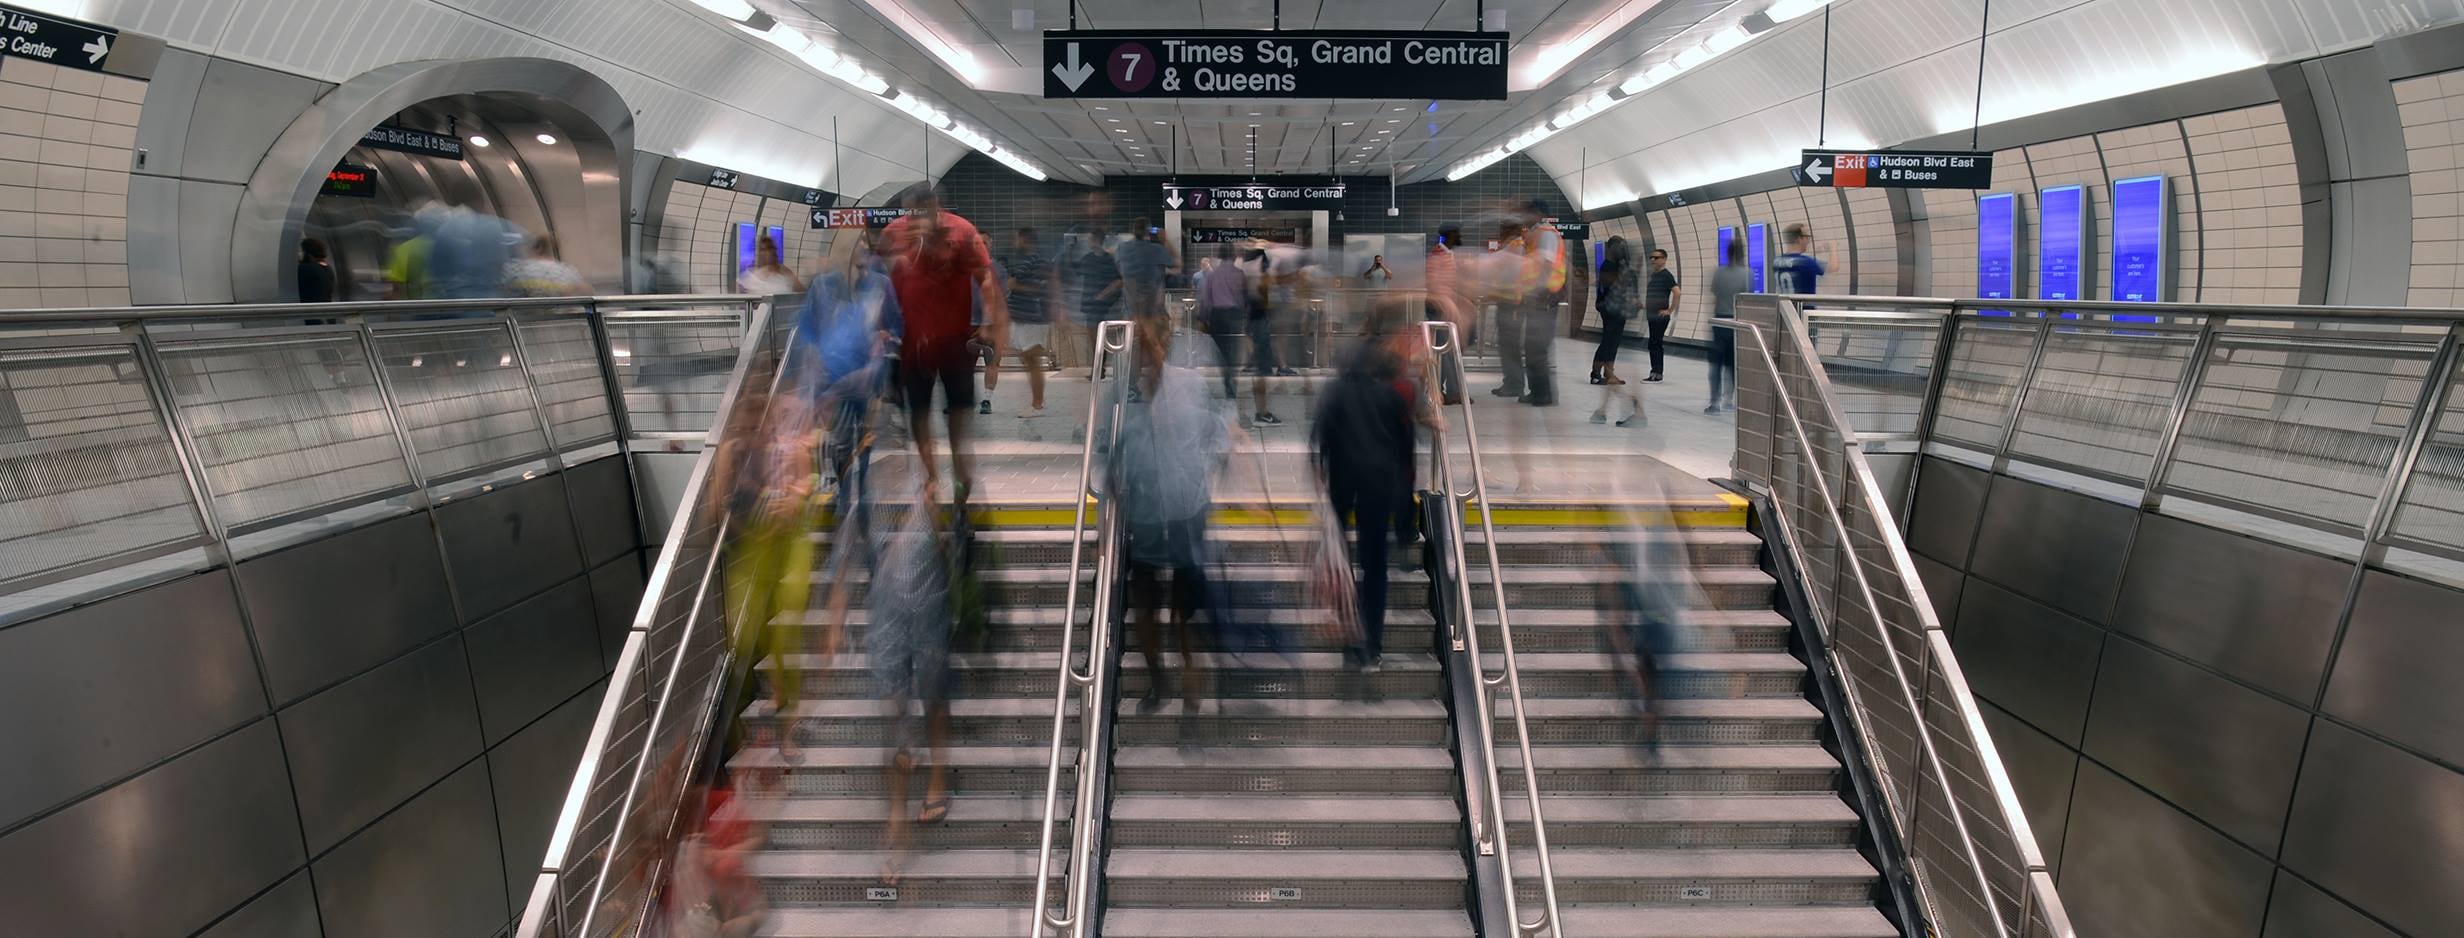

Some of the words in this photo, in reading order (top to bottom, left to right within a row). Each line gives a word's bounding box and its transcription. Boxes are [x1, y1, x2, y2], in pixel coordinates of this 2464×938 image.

[8, 14, 38, 34] Line
[11, 36, 57, 58] Center
[1162, 40, 1244, 63] Times
[1257, 40, 1298, 68] Sq,
[1311, 40, 1392, 64] Grand
[1404, 40, 1500, 65] Central
[1121, 53, 1141, 81] 7
[1162, 67, 1181, 91] &
[1194, 67, 1296, 92] Queens
[388, 130, 405, 145] Blvd
[406, 133, 423, 147] East
[424, 136, 430, 148] &
[439, 139, 459, 153] Buses
[1835, 156, 1865, 169] Exit
[1880, 156, 1920, 167] Hudson
[1924, 157, 1947, 167] Blvd
[1950, 157, 1974, 168] East
[1879, 170, 1888, 179] &
[1905, 170, 1937, 180] Buses
[1193, 193, 1202, 206] 7
[1209, 188, 1242, 198] Times
[1246, 188, 1264, 200] Sq,
[1268, 188, 1300, 198] Grand
[1304, 188, 1343, 198] Central
[1209, 199, 1218, 209] &
[1222, 199, 1263, 209] Queens
[829, 209, 865, 226] Exit
[1687, 889, 1704, 897] P6C
